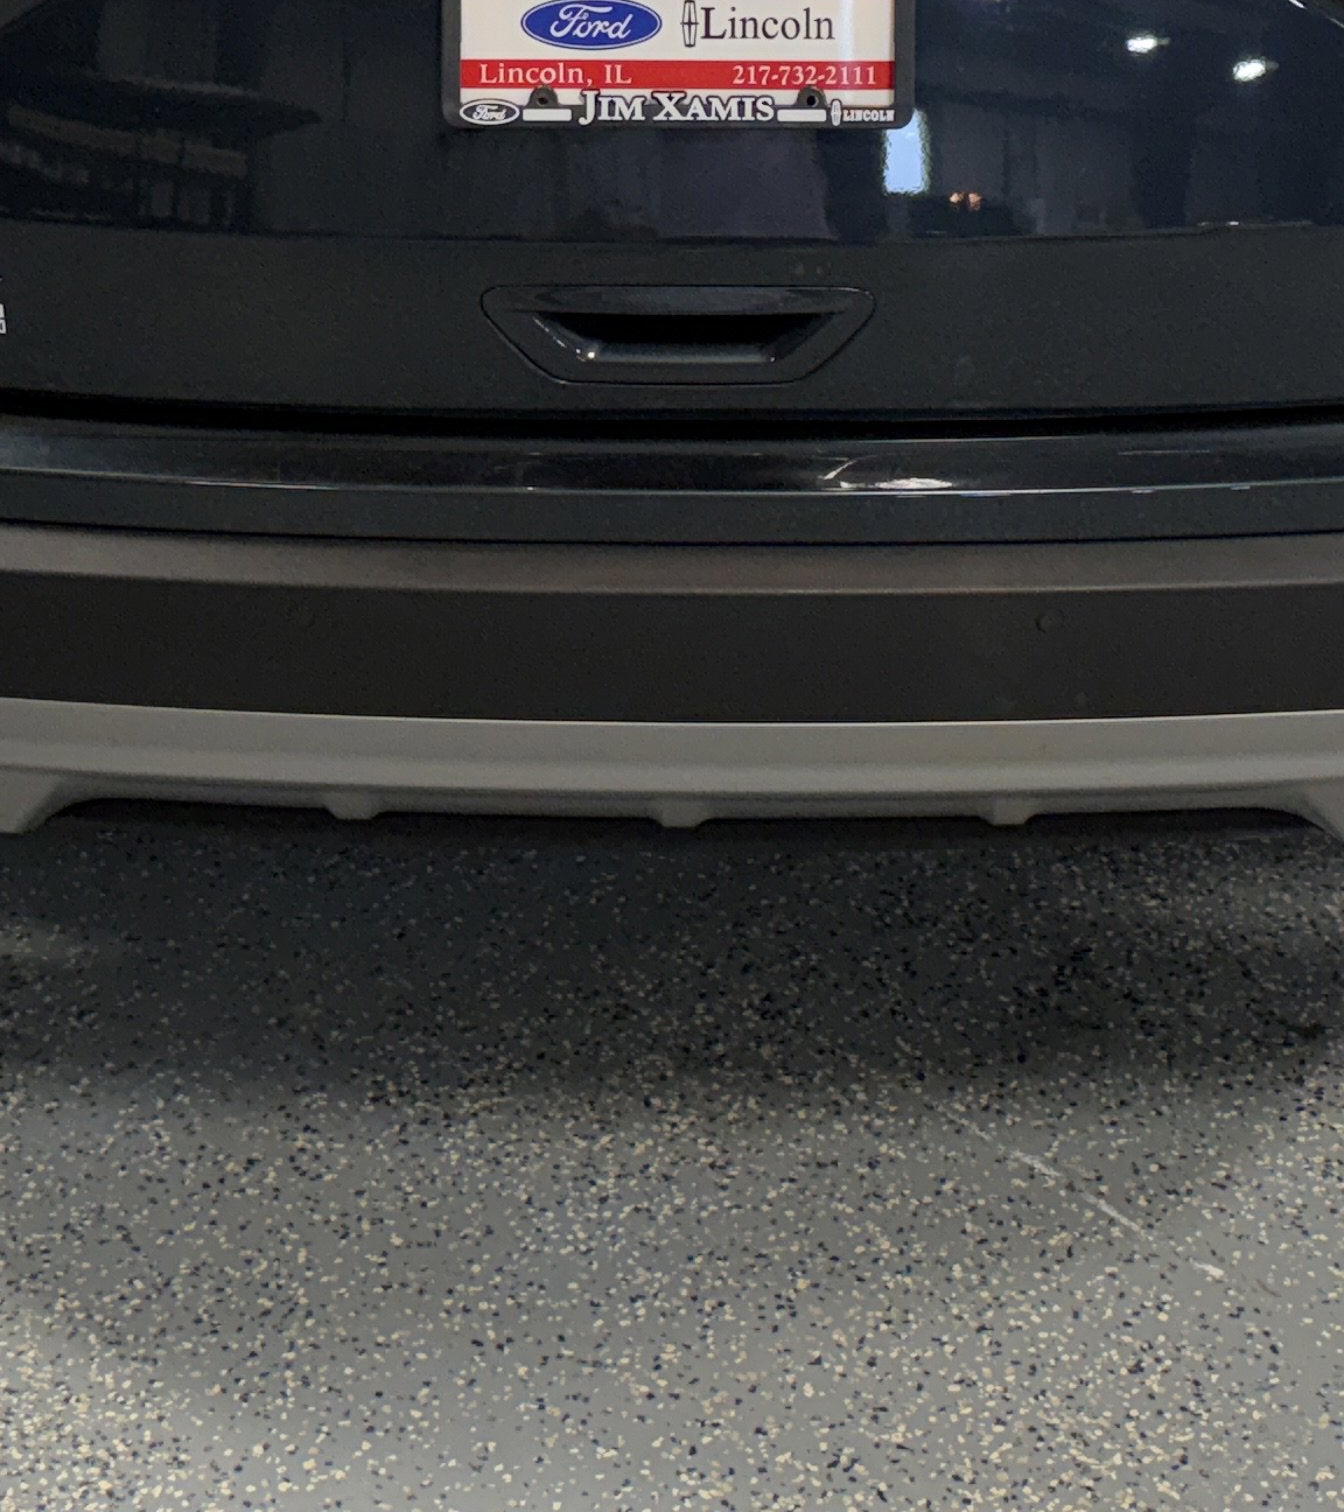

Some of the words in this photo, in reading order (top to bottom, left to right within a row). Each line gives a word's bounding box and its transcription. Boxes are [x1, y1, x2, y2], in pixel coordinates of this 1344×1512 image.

[549, 3, 633, 39] Ford
[699, 5, 836, 40] Lincoln
[479, 62, 593, 86] Lincoln,
[604, 64, 632, 84] IL
[731, 64, 877, 85] 217-732-2111
[472, 103, 506, 121] Ford
[578, 89, 646, 125] JIM
[652, 92, 775, 122] XAMIS
[842, 109, 895, 122] LINCOLN
